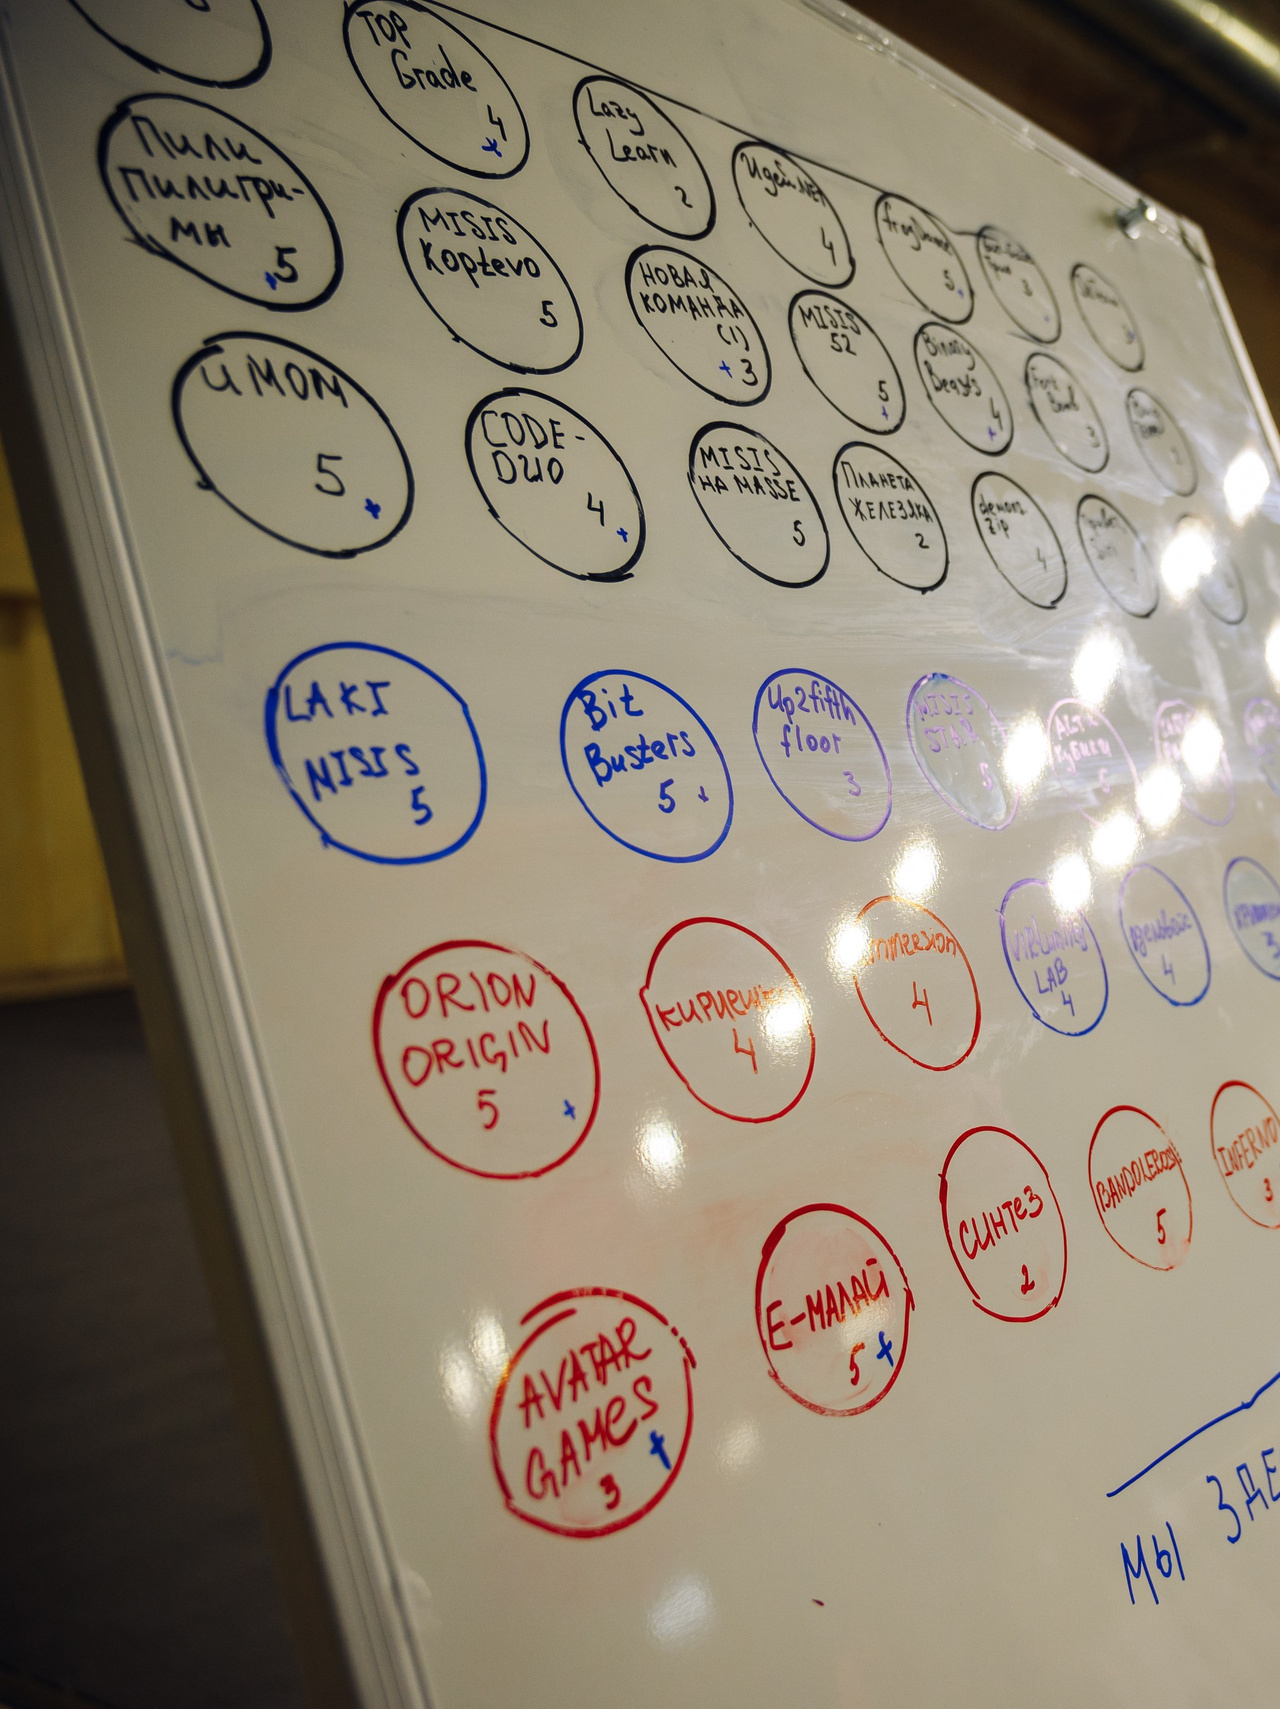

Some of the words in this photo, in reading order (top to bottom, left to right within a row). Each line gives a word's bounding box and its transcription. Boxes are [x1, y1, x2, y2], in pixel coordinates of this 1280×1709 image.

[356, 10, 411, 49] TOP
[391, 44, 477, 92] Grade
[487, 104, 507, 142] 4
[586, 86, 645, 136] Lazy
[131, 116, 261, 164] Пили
[606, 128, 677, 168] Learn
[117, 167, 305, 218] Пилигри-
[674, 186, 693, 208] 2
[418, 207, 517, 245] MISIS
[274, 247, 299, 283] 5
[419, 237, 540, 289] Koptevo
[820, 227, 836, 266] 4
[639, 261, 715, 293] НОВАЯ
[539, 300, 558, 328] 5
[639, 291, 745, 321] КОМАНДА
[798, 304, 861, 336] MISIS
[830, 333, 857, 356] 52
[740, 358, 759, 386] 3
[877, 380, 889, 402] 5
[990, 397, 1003, 432] 4
[314, 453, 345, 497] 5
[491, 451, 564, 484] DUO
[699, 446, 781, 476] MISIS
[586, 492, 605, 526] 4
[848, 497, 934, 523] ЖЕЛЕЗЯКА
[793, 520, 806, 547] 5
[914, 532, 930, 549] 2
[1037, 547, 1047, 572] 4
[285, 681, 390, 722] LAKI
[580, 683, 643, 731] Bit
[914, 693, 974, 722] MISIS
[584, 730, 696, 787] Busters
[781, 724, 842, 758] floor
[658, 779, 675, 813] 5
[843, 771, 861, 796] 3
[411, 786, 433, 825] 5
[1034, 957, 1068, 994] LAB
[1161, 953, 1176, 986] 4
[401, 972, 538, 1018] ORION
[912, 980, 933, 1027] 4
[1061, 989, 1075, 1017] 4
[402, 1019, 551, 1087] ORIGIN
[732, 1028, 758, 1075] 4
[478, 1088, 499, 1130] 5
[1217, 1116, 1278, 1177] INFERNO
[1156, 1207, 1167, 1245] 5
[1020, 1264, 1035, 1295] 2
[518, 1316, 653, 1428] AVATAR
[849, 1341, 865, 1386] 5
[600, 1473, 621, 1510] 3
[1120, 1520, 1186, 1606] МЫ
